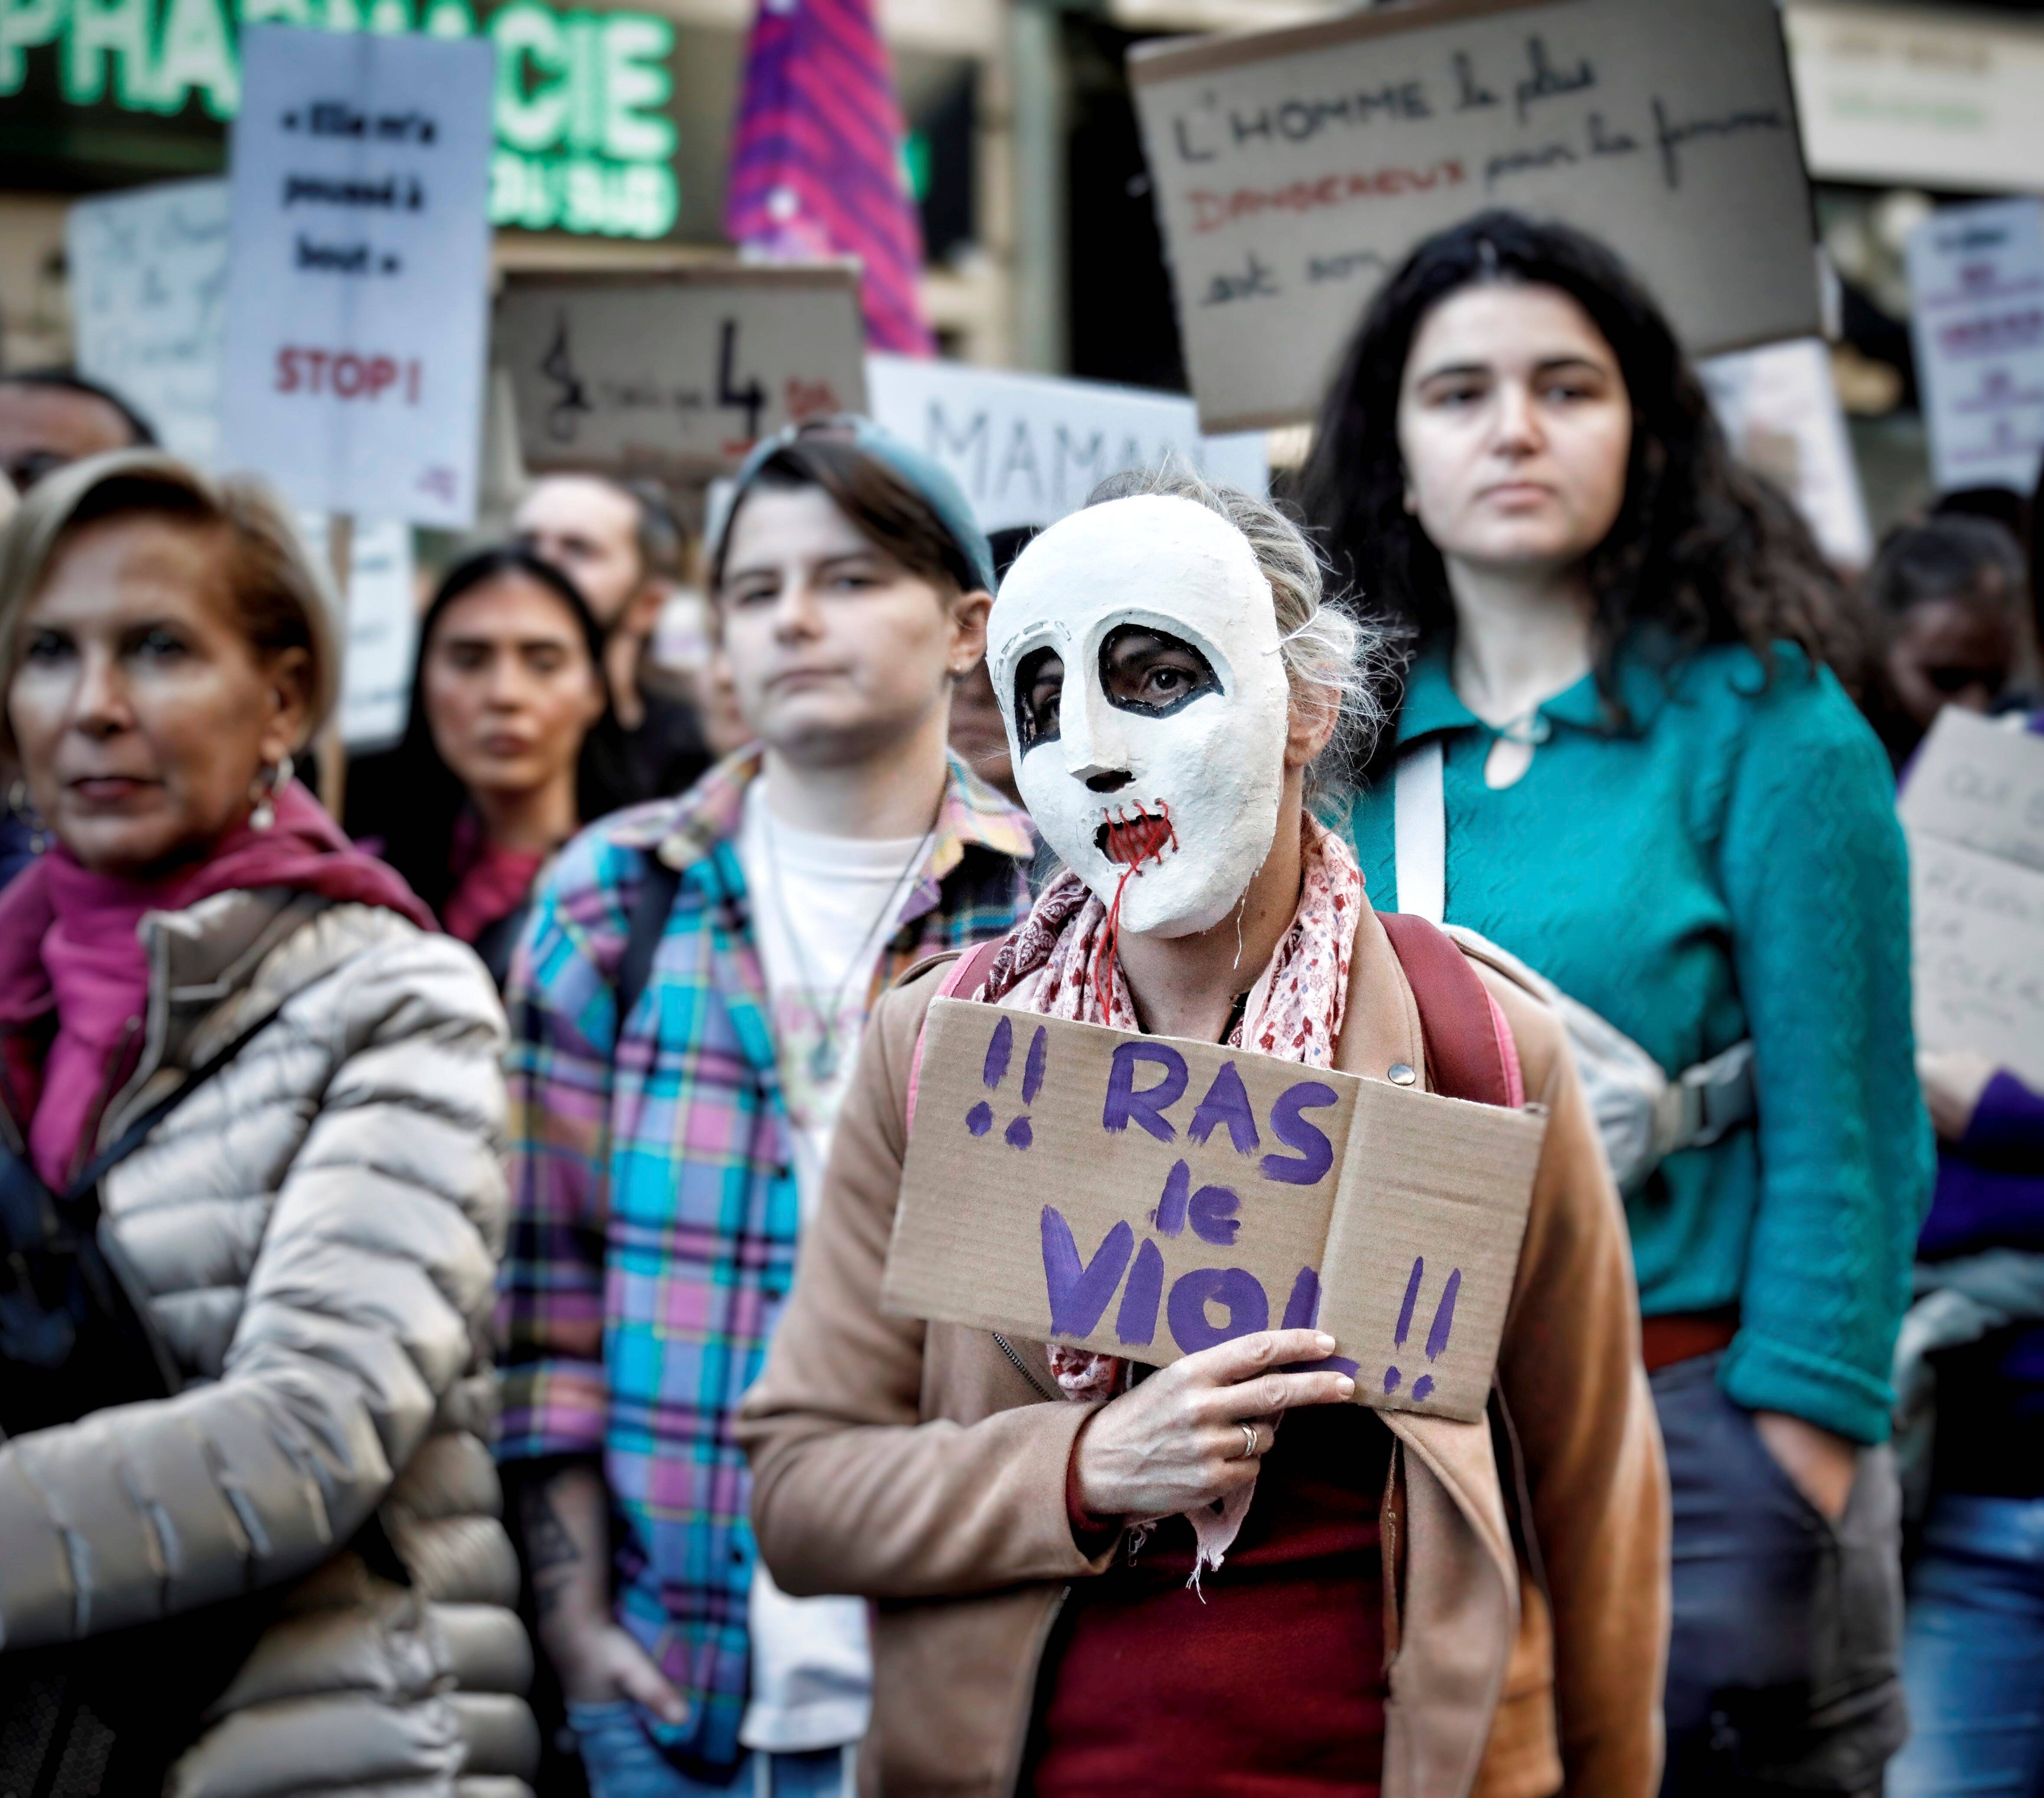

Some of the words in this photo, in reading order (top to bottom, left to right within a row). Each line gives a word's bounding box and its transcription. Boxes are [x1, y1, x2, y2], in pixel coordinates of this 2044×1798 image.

[0, 0, 677, 164] PHACIE
[1515, 33, 1597, 126] plus
[1102, 1041, 1339, 1186] RAS
[1148, 1159, 1241, 1245] le
[1041, 1205, 1359, 1379] VIOL
